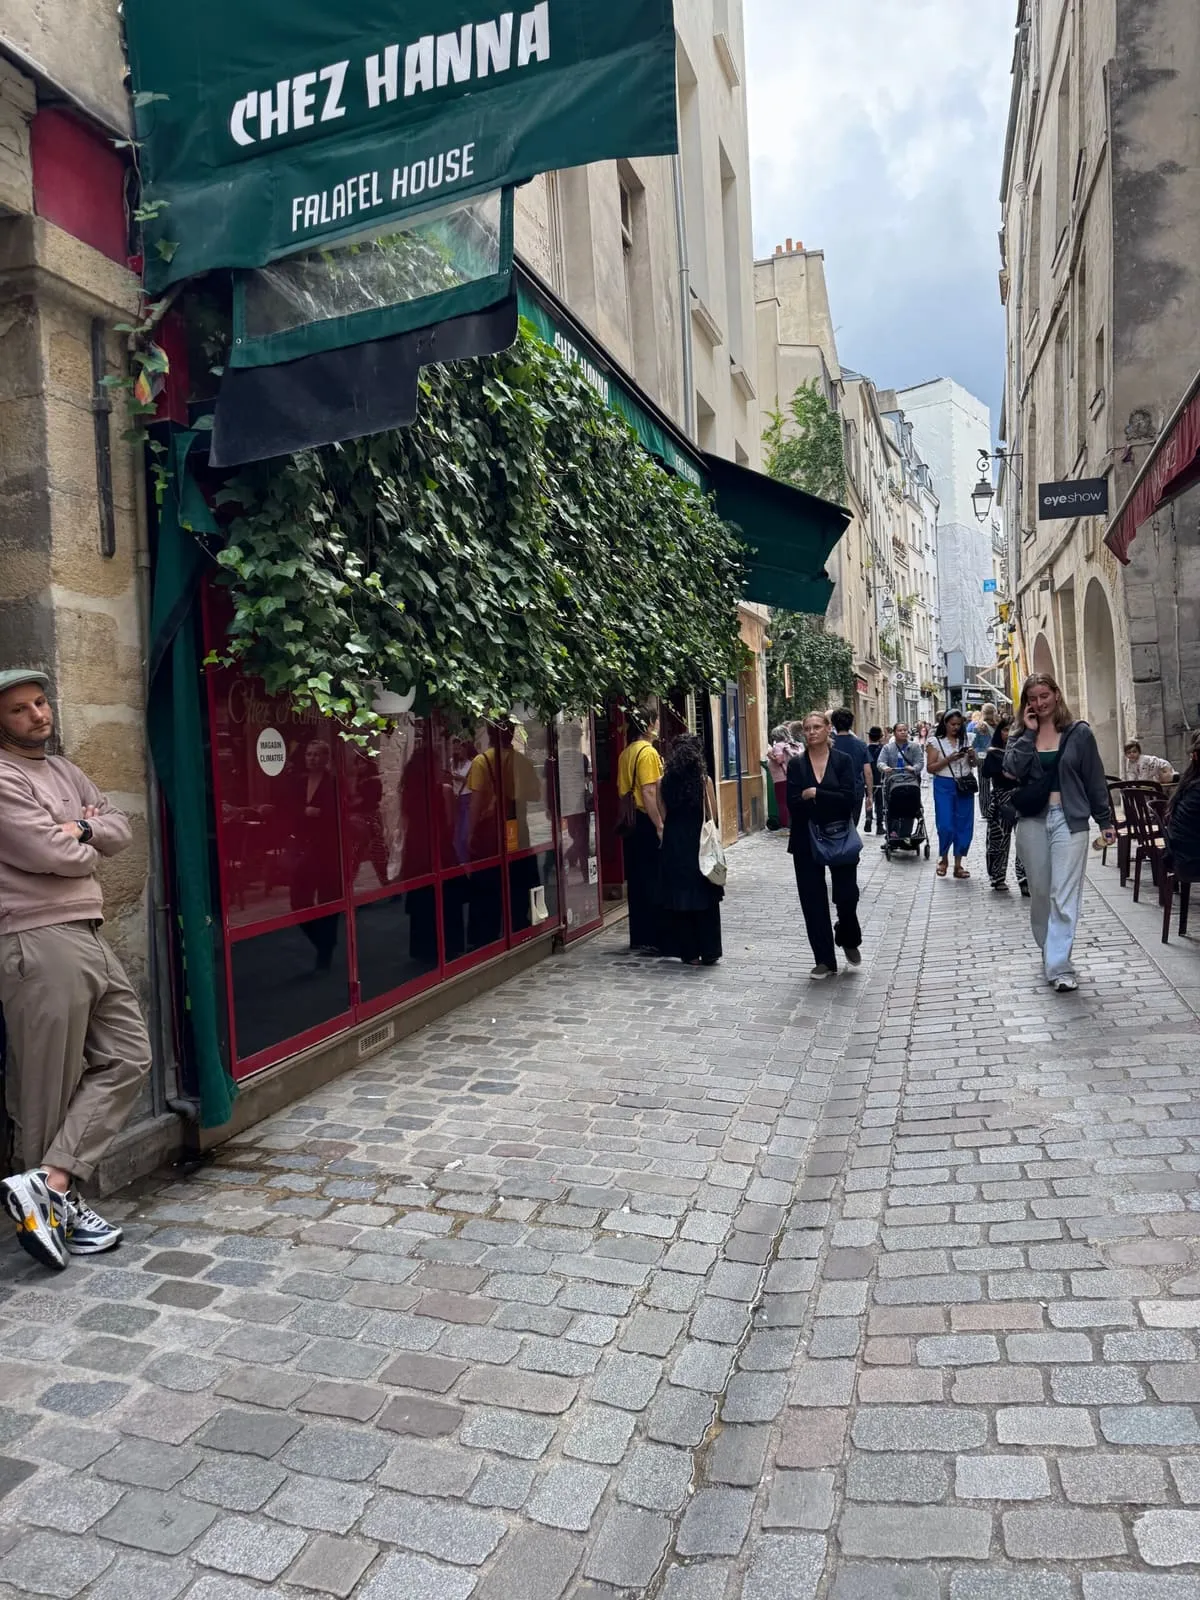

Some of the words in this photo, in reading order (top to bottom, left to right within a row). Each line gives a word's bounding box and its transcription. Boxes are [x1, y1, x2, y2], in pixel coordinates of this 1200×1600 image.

[230, 60, 350, 146] CHEZ
[365, 0, 550, 108] HANNA
[292, 171, 383, 232] FALAFEL
[391, 142, 475, 200] HOUSE
[1043, 491, 1102, 507] eyeshow
[260, 741, 282, 750] MAGASIN
